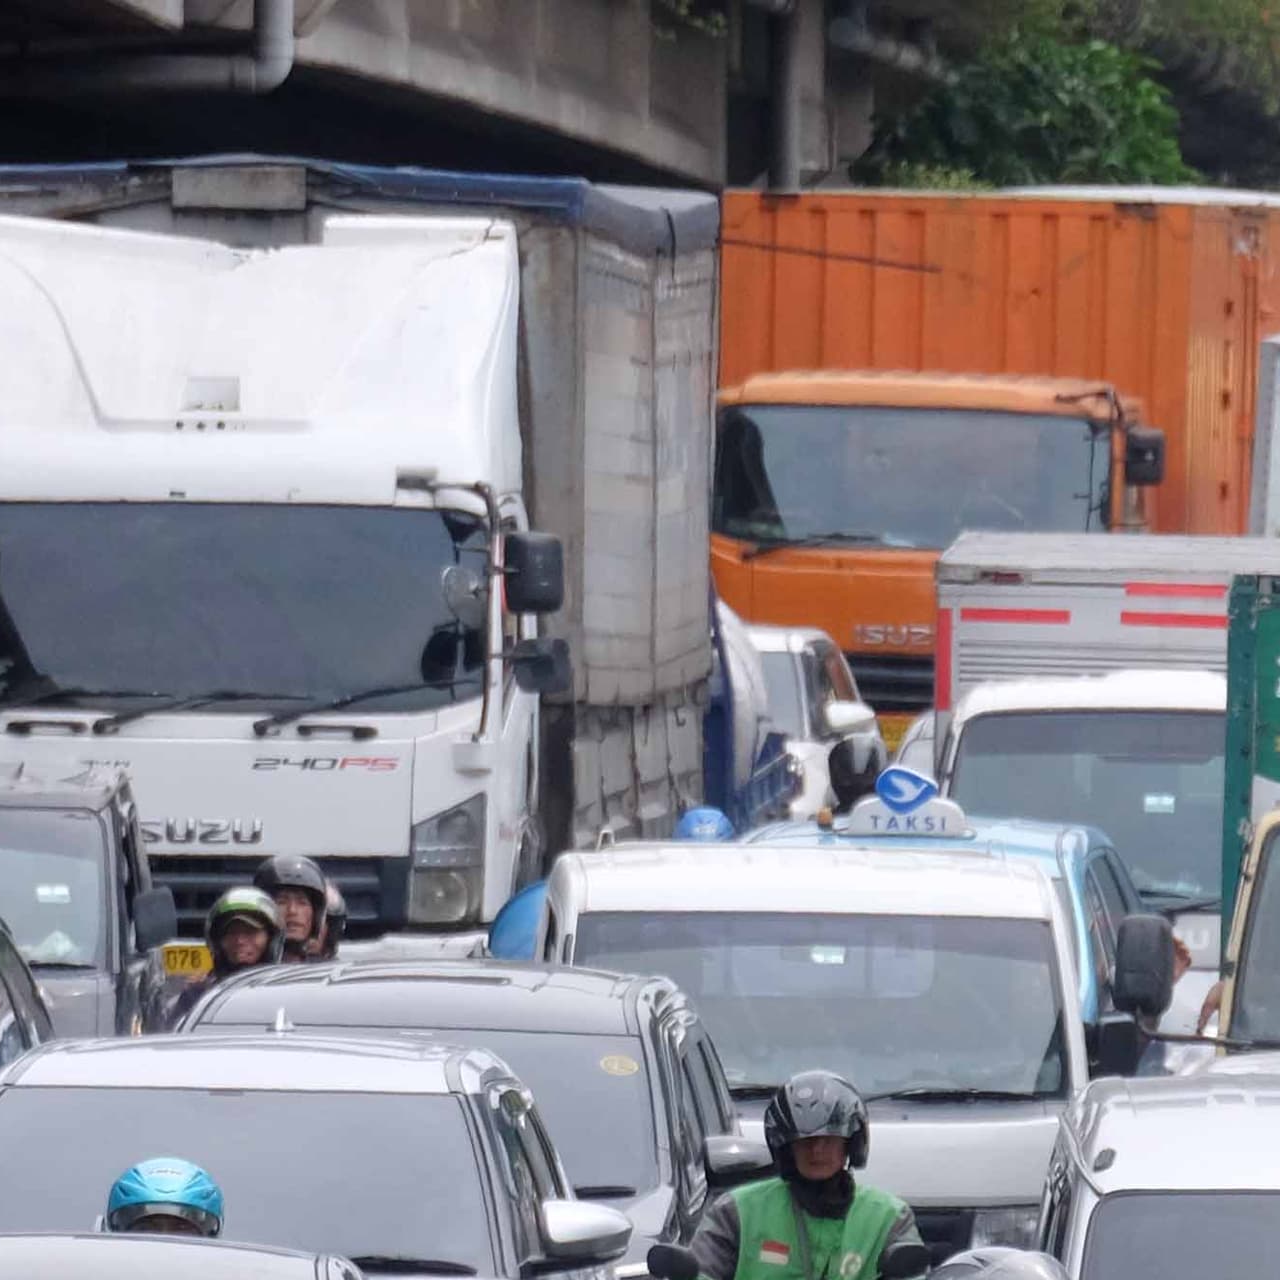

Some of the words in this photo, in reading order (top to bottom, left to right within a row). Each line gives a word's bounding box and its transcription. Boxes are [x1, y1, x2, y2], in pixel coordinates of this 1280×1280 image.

[854, 624, 933, 645] ISUZ
[252, 757, 400, 771] 240PS
[138, 817, 264, 844] SUZU
[870, 815, 947, 832] TAKSI
